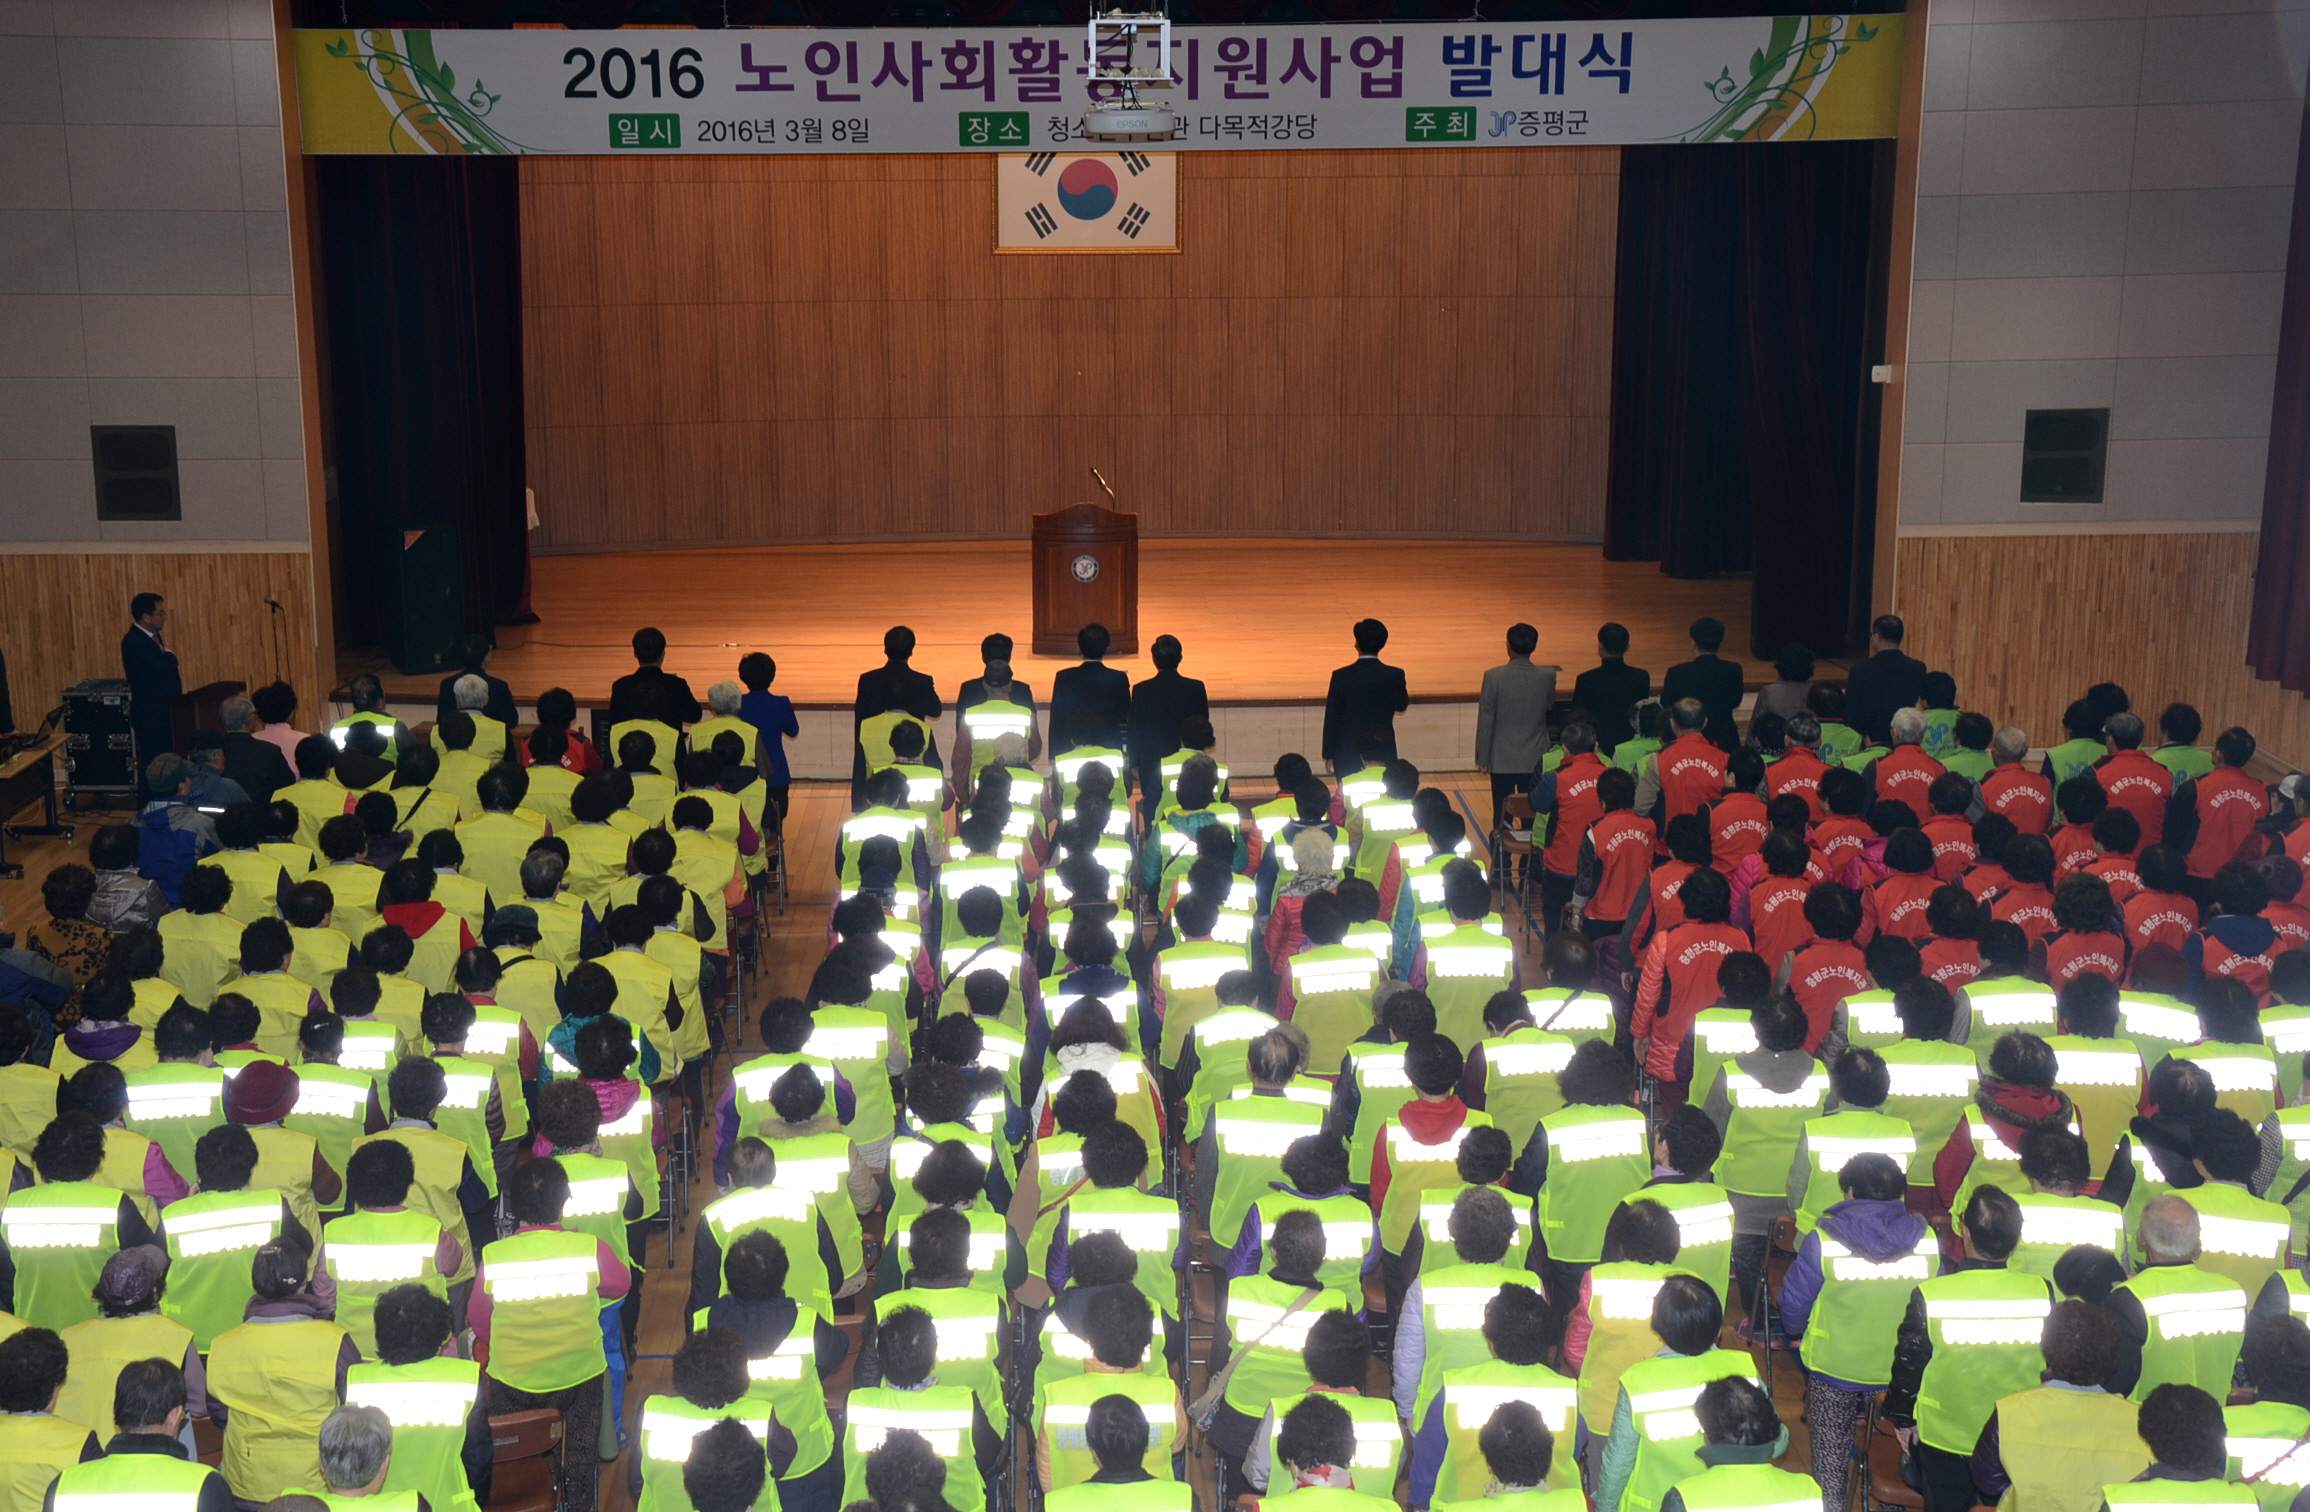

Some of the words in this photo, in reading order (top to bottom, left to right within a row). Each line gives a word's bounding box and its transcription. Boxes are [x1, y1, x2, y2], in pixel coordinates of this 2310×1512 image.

[563, 47, 704, 99] 2016
[1443, 32, 1632, 97] 발대식
[698, 118, 775, 144] 2016년
[786, 118, 822, 143] 3월
[832, 118, 869, 143] 8일
[1116, 120, 1148, 129] EPSON
[1199, 114, 1318, 141] 다목적강당
[1518, 110, 1589, 136] 증평군
[1887, 769, 1934, 787] 증평군노인복지
[1763, 889, 1807, 913] 증평군노인복
[2138, 911, 2193, 936] 증평군노인복지관
[1678, 940, 1733, 965] 증평군노인복지
[1804, 965, 1868, 990] 증평군노인복지관
[2060, 953, 2119, 978] 증평군노인복지관
